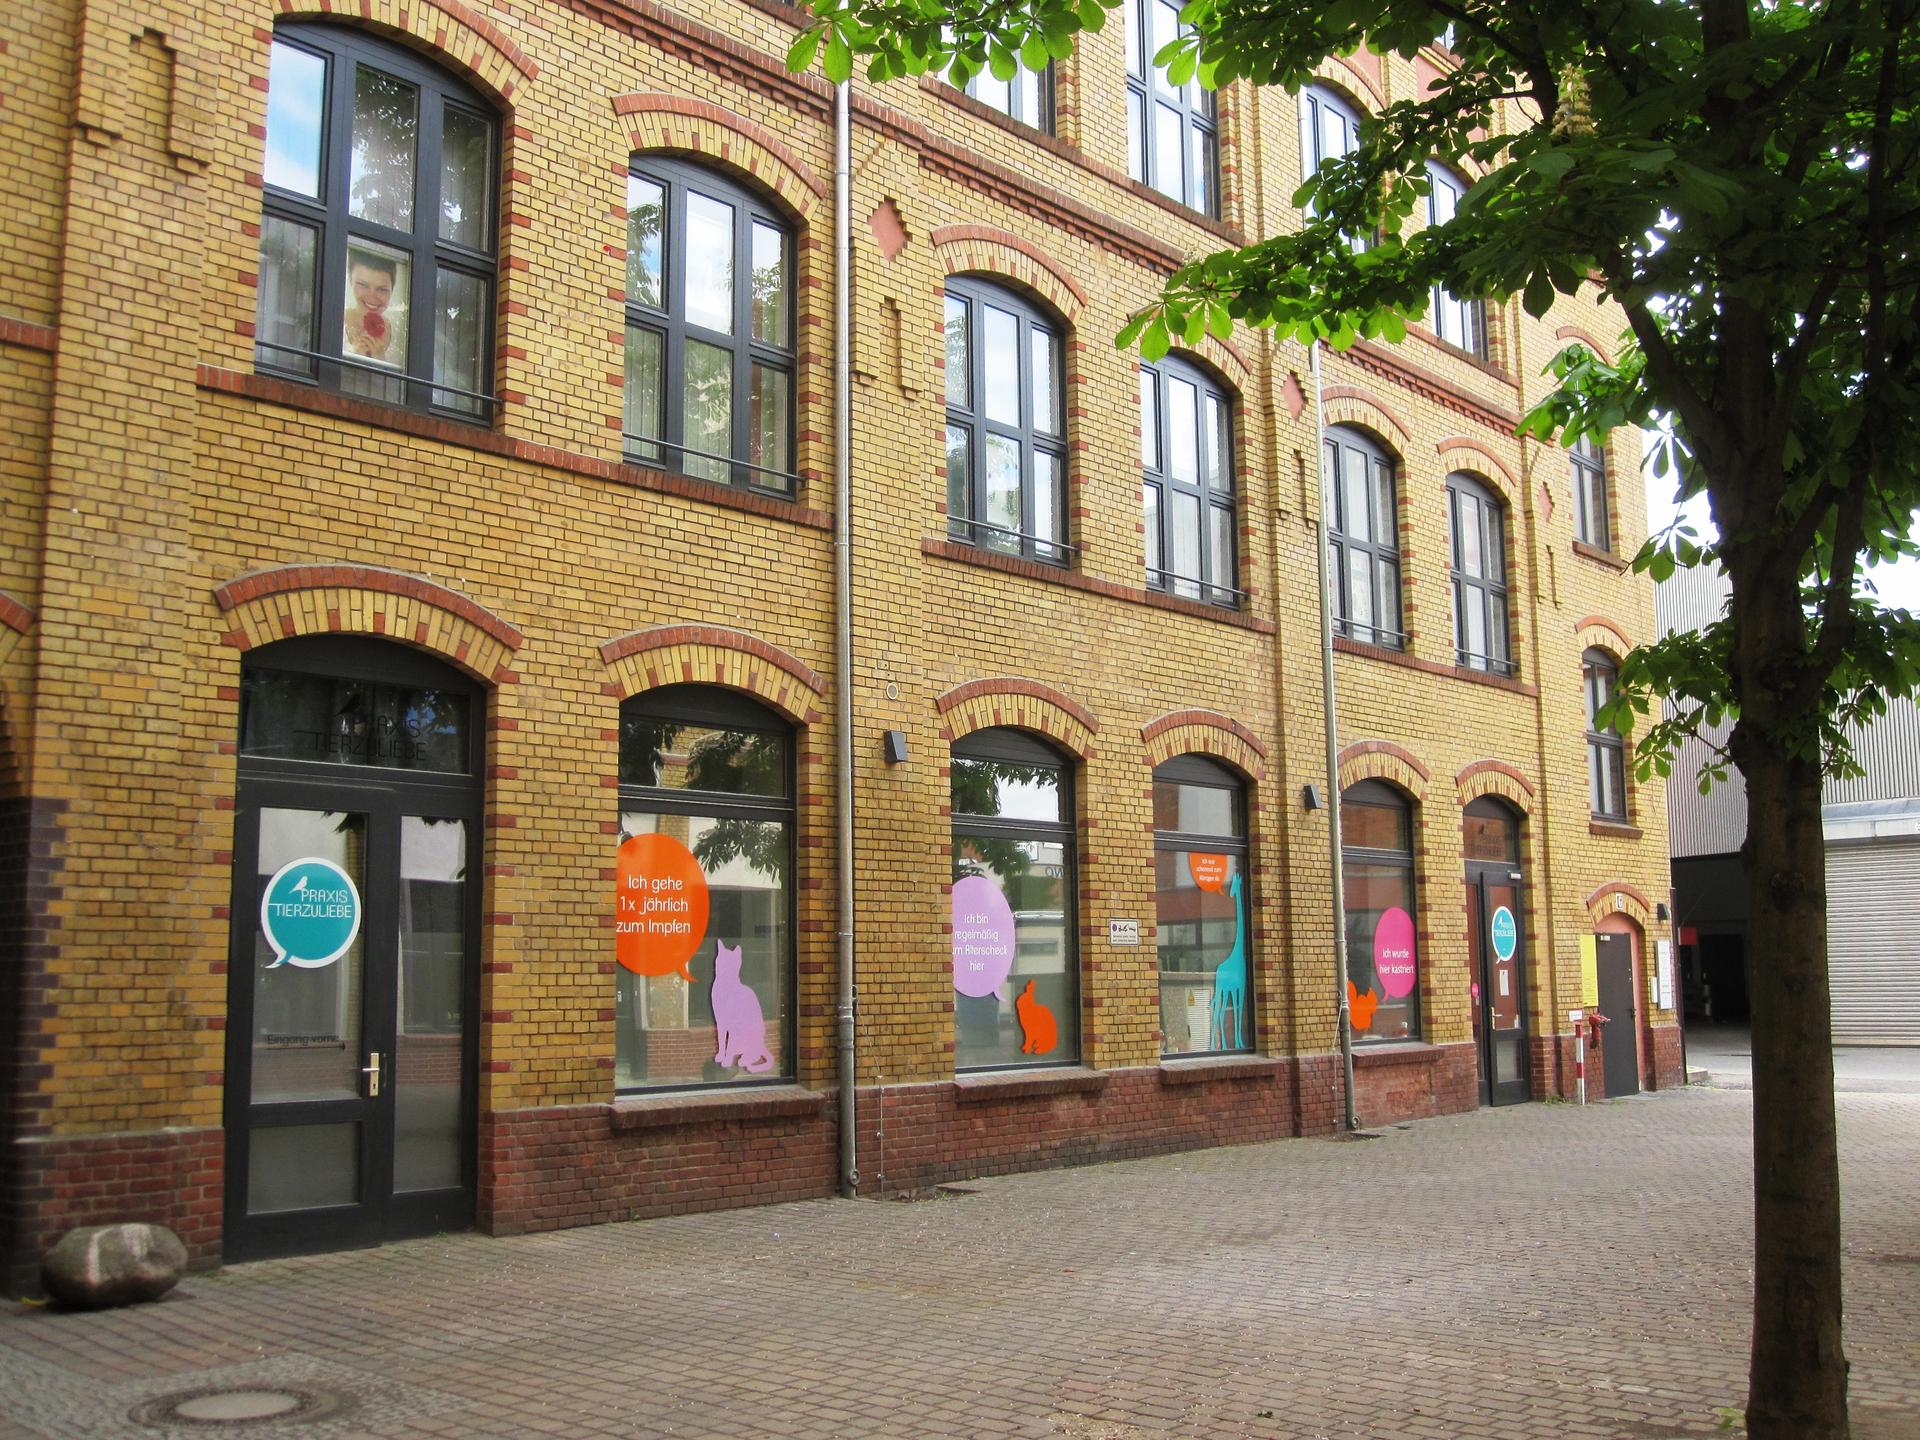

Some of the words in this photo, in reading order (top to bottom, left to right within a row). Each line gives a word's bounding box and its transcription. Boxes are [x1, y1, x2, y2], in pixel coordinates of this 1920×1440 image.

[356, 714, 420, 738] AXIS
[628, 874, 648, 889] Ich
[651, 875, 683, 894] gehe
[301, 889, 348, 903] PRAXIS
[268, 903, 352, 918] TIERZULIEBE
[620, 896, 636, 911] 1x
[639, 896, 689, 915] jährlich
[964, 913, 975, 924] Ich
[976, 912, 989, 924] bin
[616, 921, 645, 933] zum
[648, 918, 691, 936] Impfen
[1382, 948, 1391, 958] Ich
[1392, 948, 1409, 958] wurde
[969, 960, 985, 971] hier
[1379, 964, 1390, 974] hier
[1391, 964, 1414, 974] kastriert
